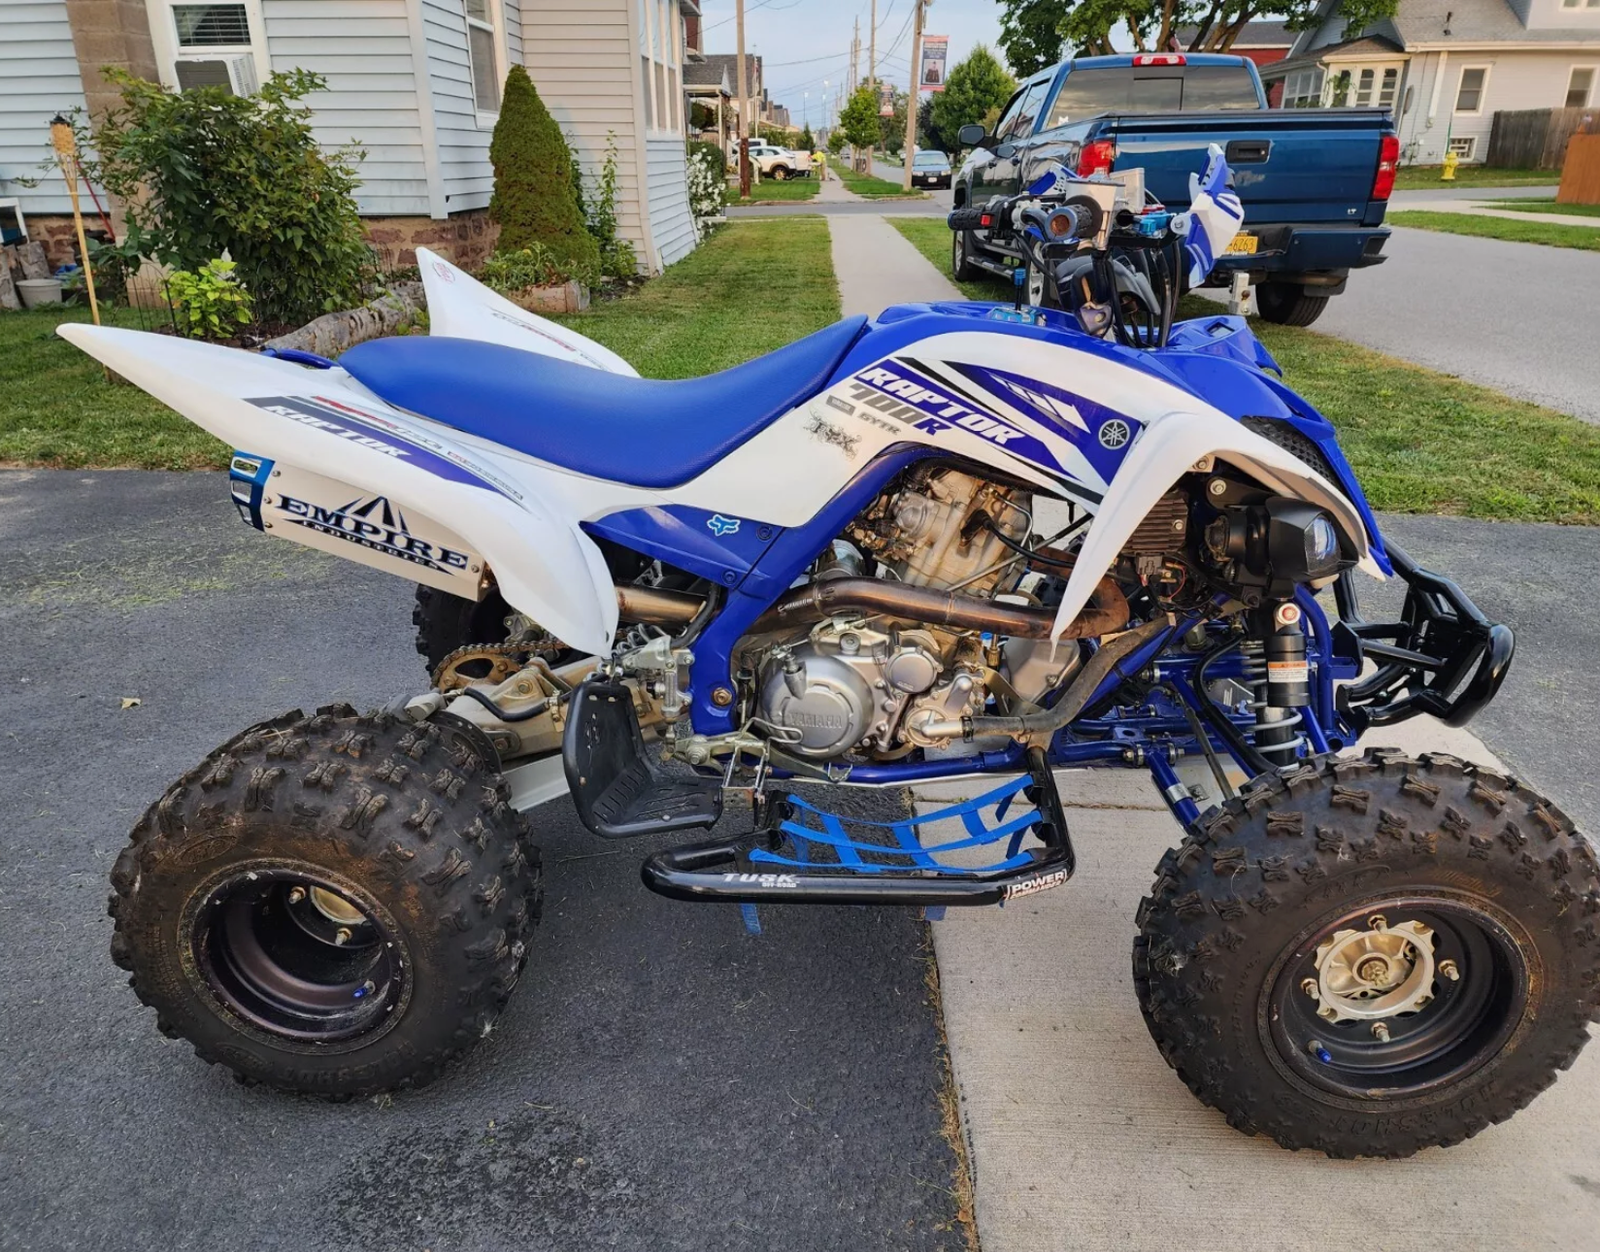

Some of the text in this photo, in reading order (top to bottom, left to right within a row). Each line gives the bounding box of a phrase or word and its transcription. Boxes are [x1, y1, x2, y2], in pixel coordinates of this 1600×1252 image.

[262, 405, 413, 458] RAPTOR
[849, 382, 952, 436] 700R
[858, 367, 1026, 445] RAPTOR
[274, 493, 469, 570] EMPIRE
[302, 519, 440, 571] INDUSTRIES
[723, 873, 797, 882] TUSK
[1011, 871, 1065, 894] POWER
